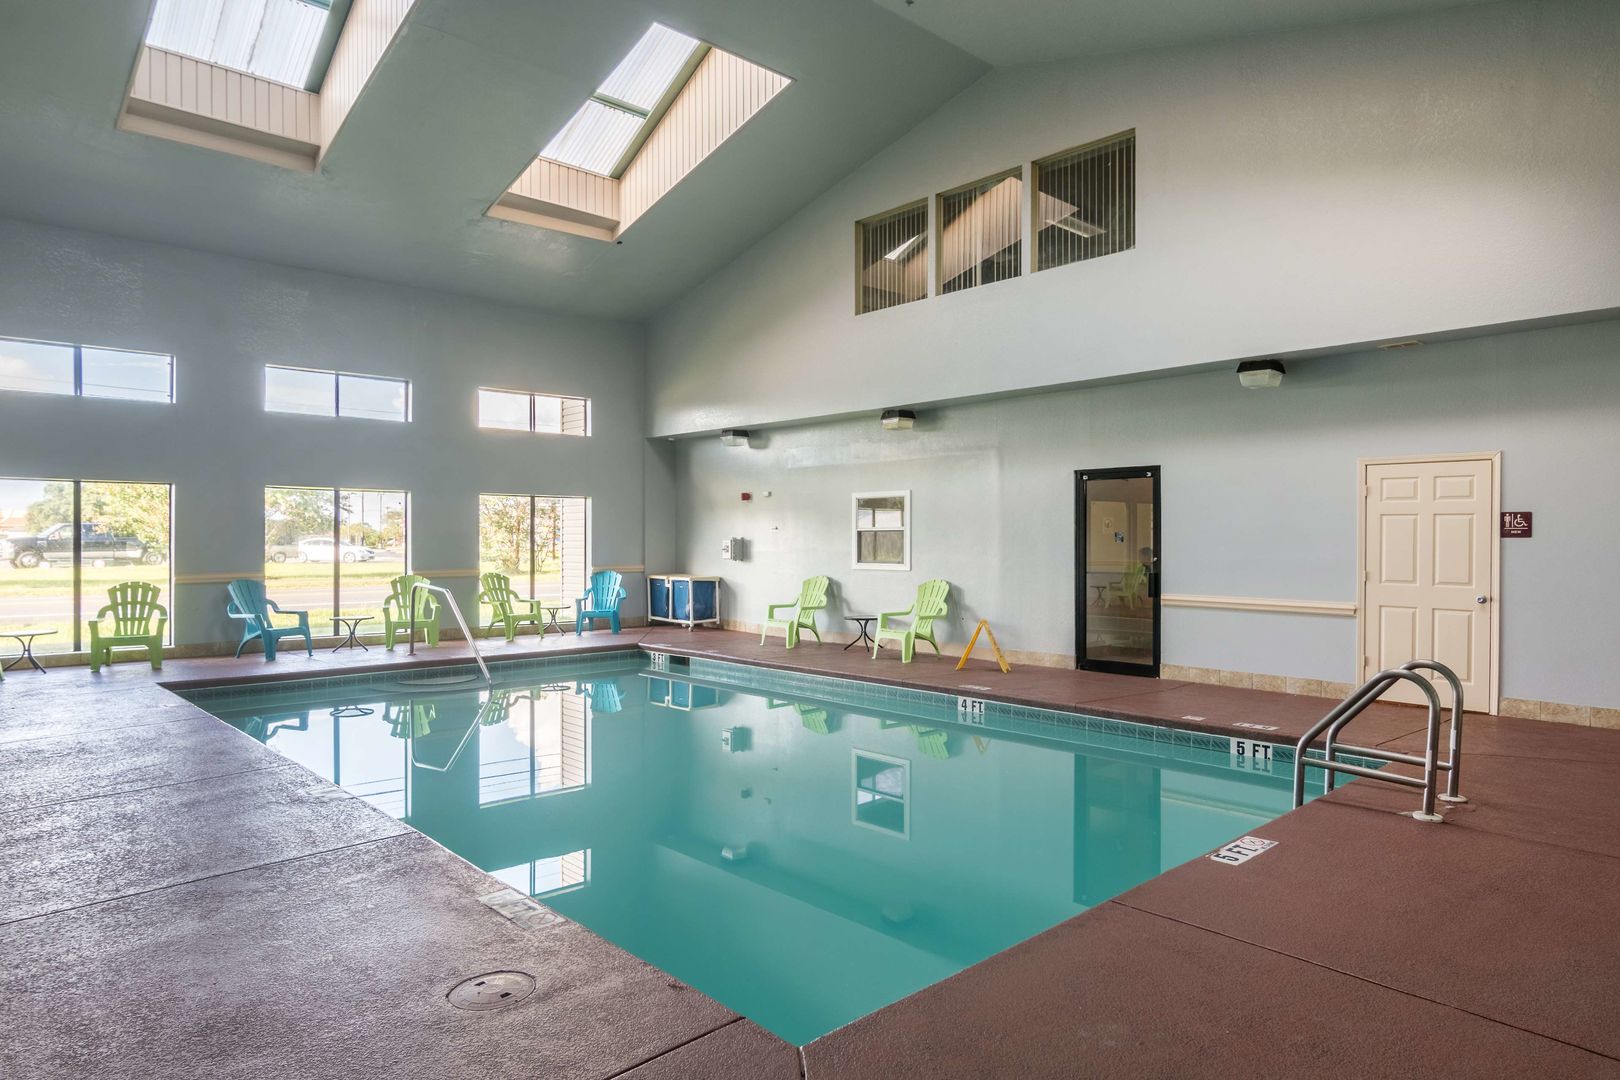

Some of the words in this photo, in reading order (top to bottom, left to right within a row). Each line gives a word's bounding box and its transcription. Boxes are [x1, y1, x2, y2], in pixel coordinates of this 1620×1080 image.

[961, 699, 968, 711] 4
[1236, 741, 1245, 756] 5
[1213, 853, 1240, 862] 5
